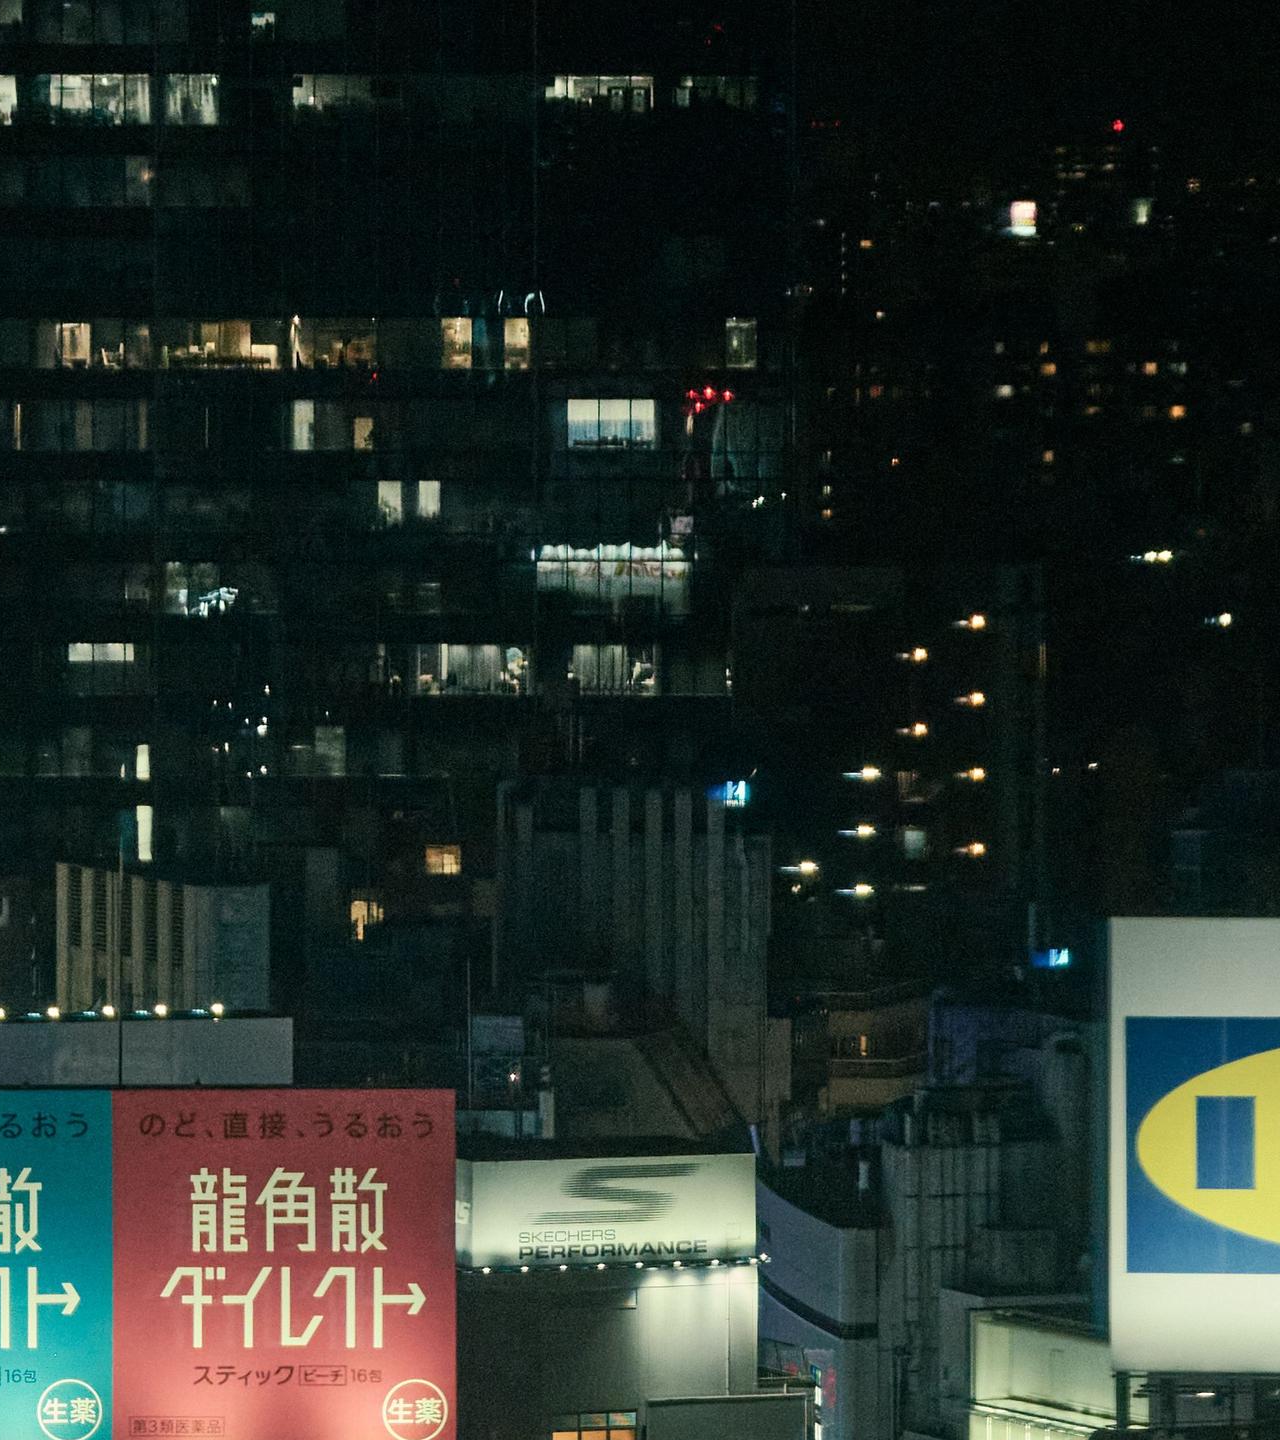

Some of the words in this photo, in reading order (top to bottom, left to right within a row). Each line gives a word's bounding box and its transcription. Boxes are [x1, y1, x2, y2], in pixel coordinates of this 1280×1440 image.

[138, 1110, 435, 1140] のど、直接、うるおう
[189, 1166, 389, 1254] 龍角散
[519, 1229, 616, 1243] SKECHERS
[519, 1240, 708, 1260] PERFORMANCE
[160, 1266, 427, 1349] ダイレクト
[192, 1365, 296, 1388] スティック
[301, 1368, 345, 1385] ピーチ
[43, 1394, 95, 1425] 生薬
[389, 1394, 441, 1425] 生薬
